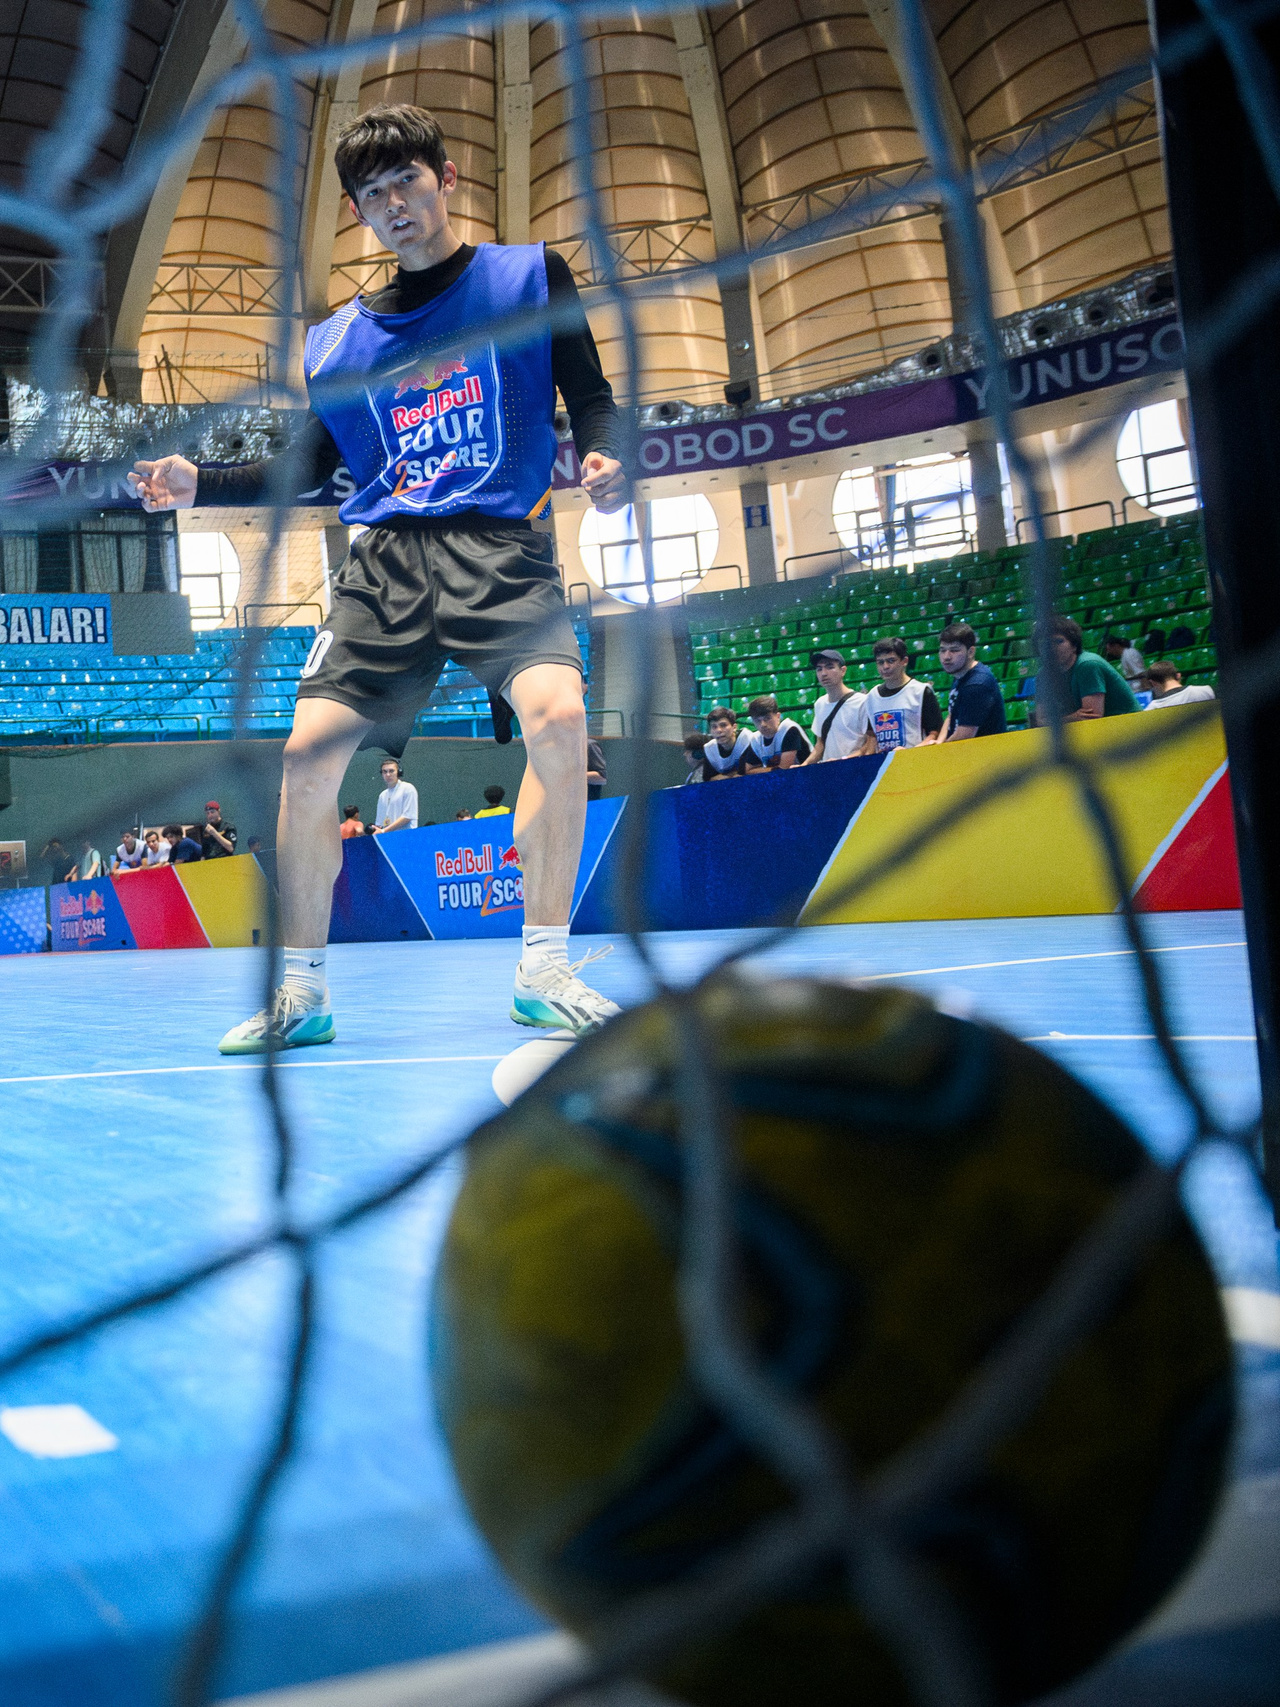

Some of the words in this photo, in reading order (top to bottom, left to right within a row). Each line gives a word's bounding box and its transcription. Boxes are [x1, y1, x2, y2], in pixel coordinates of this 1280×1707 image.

[390, 393, 437, 433] Red
[437, 375, 484, 416] Bull
[398, 407, 485, 455] FOUR
[789, 407, 849, 448] SC
[333, 466, 358, 499] S
[745, 504, 768, 529] H
[435, 848, 464, 878] Red
[464, 844, 493, 874] Bull
[439, 882, 482, 909] FOUR
[492, 876, 524, 906] SCO
